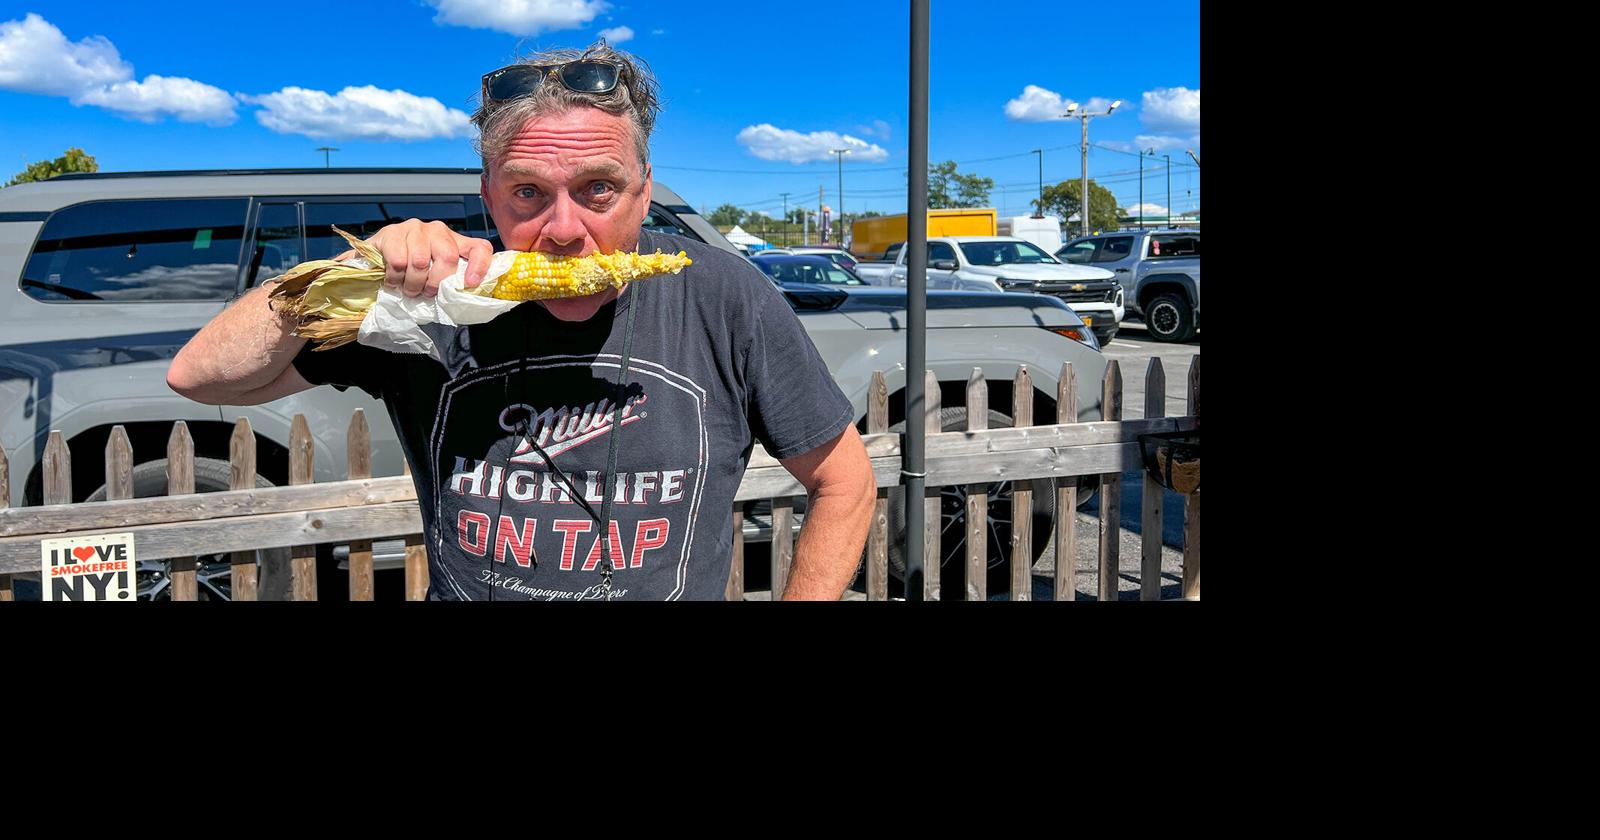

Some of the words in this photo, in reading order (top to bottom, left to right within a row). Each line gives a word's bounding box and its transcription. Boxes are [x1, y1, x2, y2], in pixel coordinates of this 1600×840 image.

[450, 456, 575, 504] HIGH
[585, 468, 688, 504] LIFE
[457, 509, 538, 568] ON
[552, 517, 670, 571] TAP
[51, 549, 59, 566] I
[51, 561, 128, 576] SMOKEFREE
[51, 571, 129, 601] NY!
[502, 577, 574, 601] Champagne
[573, 586, 593, 601] of
[585, 584, 628, 600] Bers
